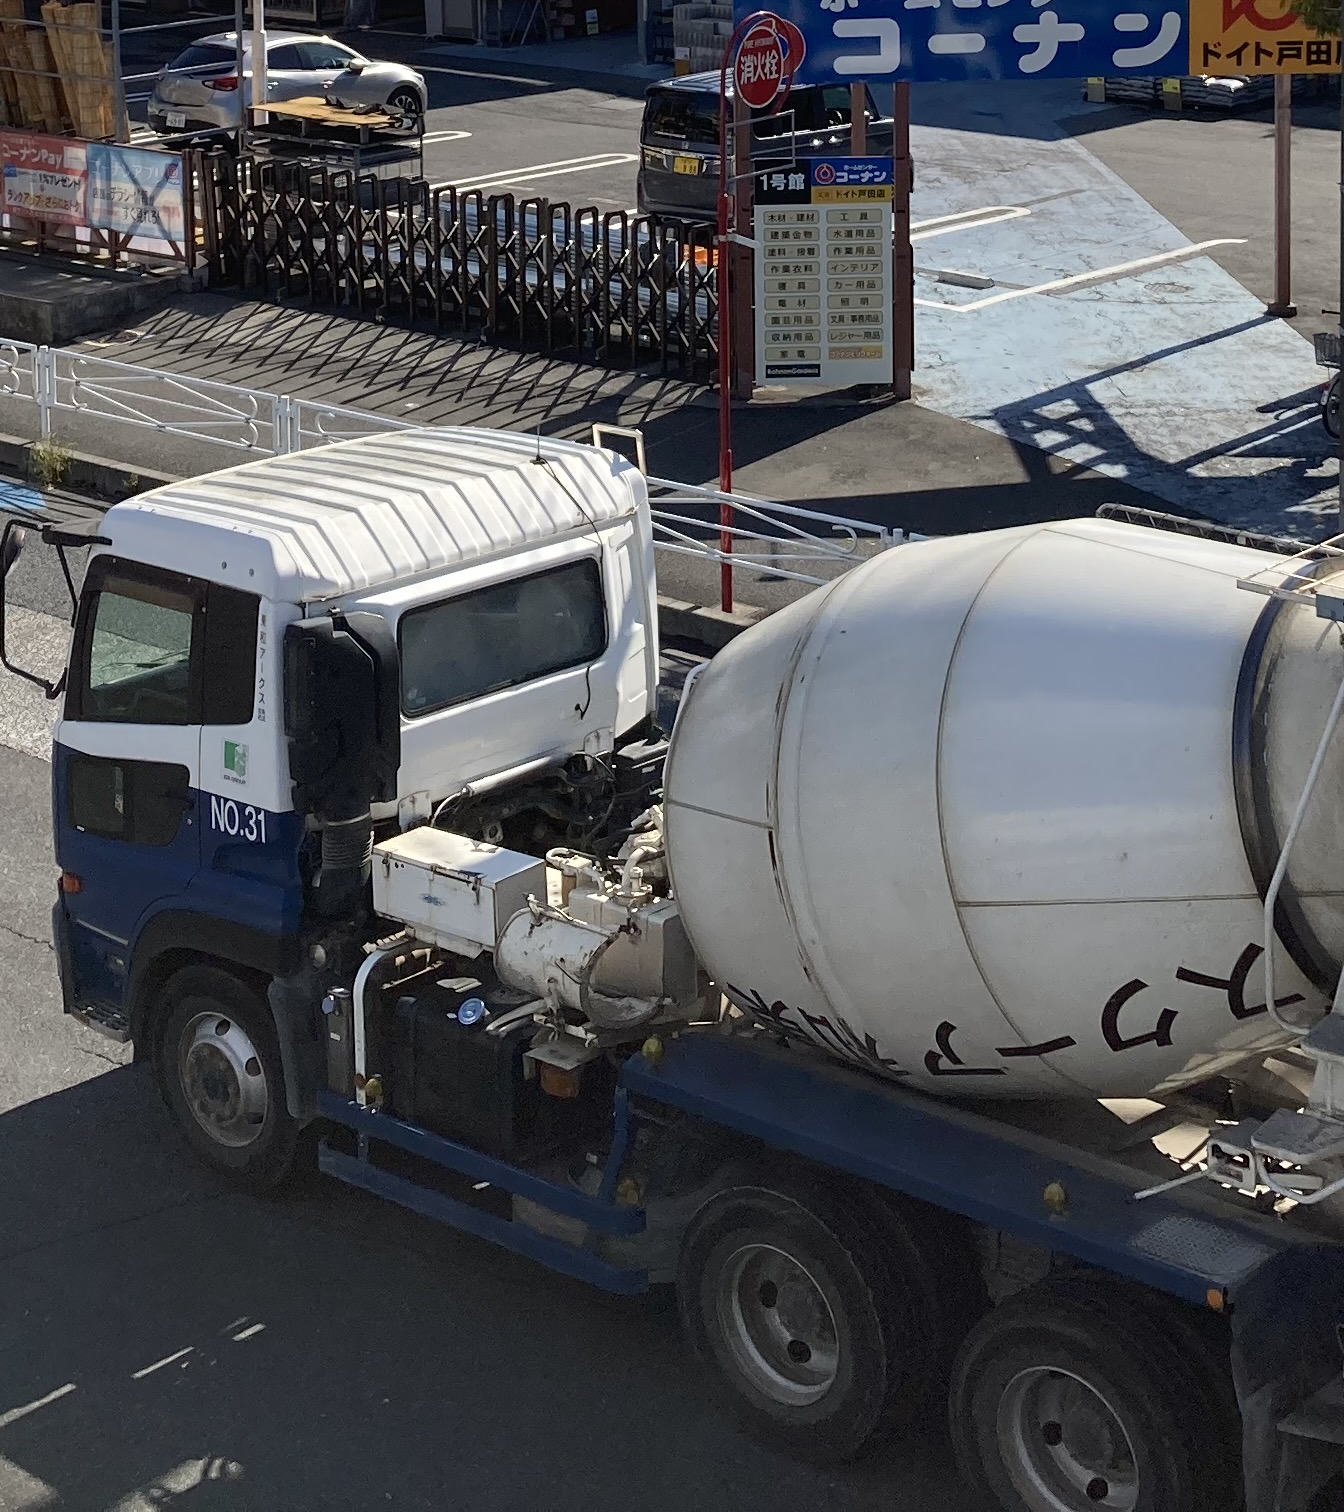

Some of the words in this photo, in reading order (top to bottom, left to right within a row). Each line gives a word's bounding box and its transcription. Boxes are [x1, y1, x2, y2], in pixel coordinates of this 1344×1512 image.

[832, 10, 1182, 76] コーナン
[740, 49, 779, 85] 消火栓
[759, 173, 805, 191] 1号館
[836, 171, 887, 183] コーナン
[836, 189, 886, 199] ドイト戸田店
[768, 213, 815, 223] 木材・建材
[840, 212, 868, 221] 工具
[833, 229, 876, 239] 水道用品
[830, 263, 880, 273] インテリア
[835, 280, 876, 290] カー用品
[830, 331, 881, 341] レジャー用品
[210, 795, 266, 844] NO.31
